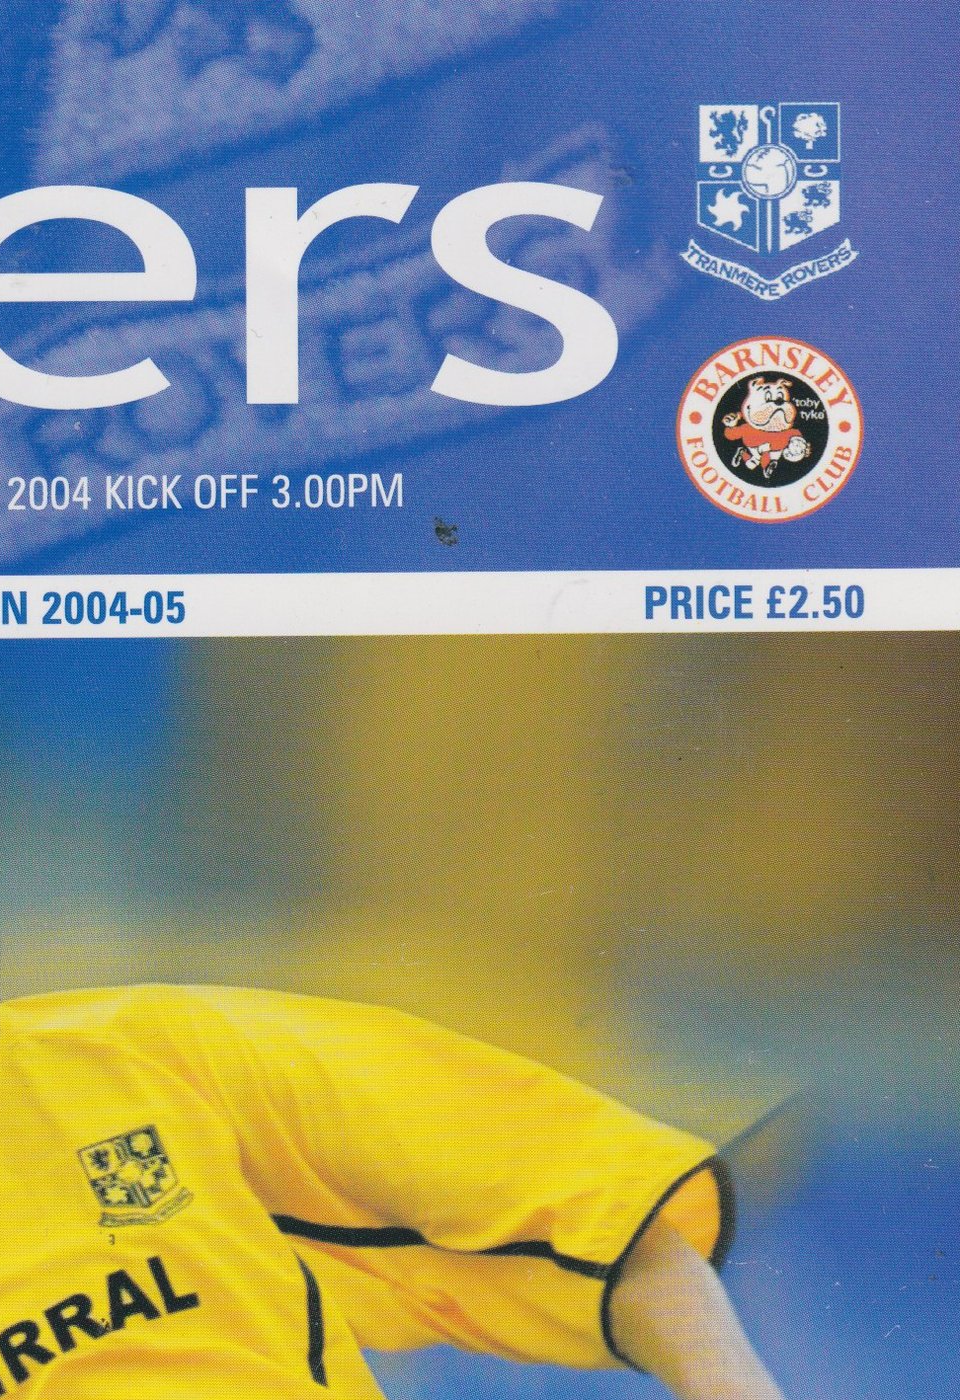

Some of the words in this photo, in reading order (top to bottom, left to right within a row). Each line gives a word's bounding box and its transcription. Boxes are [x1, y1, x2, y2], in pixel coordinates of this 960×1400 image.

[690, 246, 780, 296] TRANMERE
[783, 248, 853, 289] ROVERS
[692, 343, 852, 408] BARNSLEY
[8, 476, 91, 511] 2004
[106, 475, 185, 510] KICK
[194, 474, 260, 509] OFF
[271, 473, 404, 509] 3.00PM
[687, 437, 788, 512] FOOTBALL
[803, 446, 852, 501] CLUB
[42, 591, 186, 625] 2004-05
[645, 586, 753, 621] PRICE
[766, 585, 865, 620] £2.50
